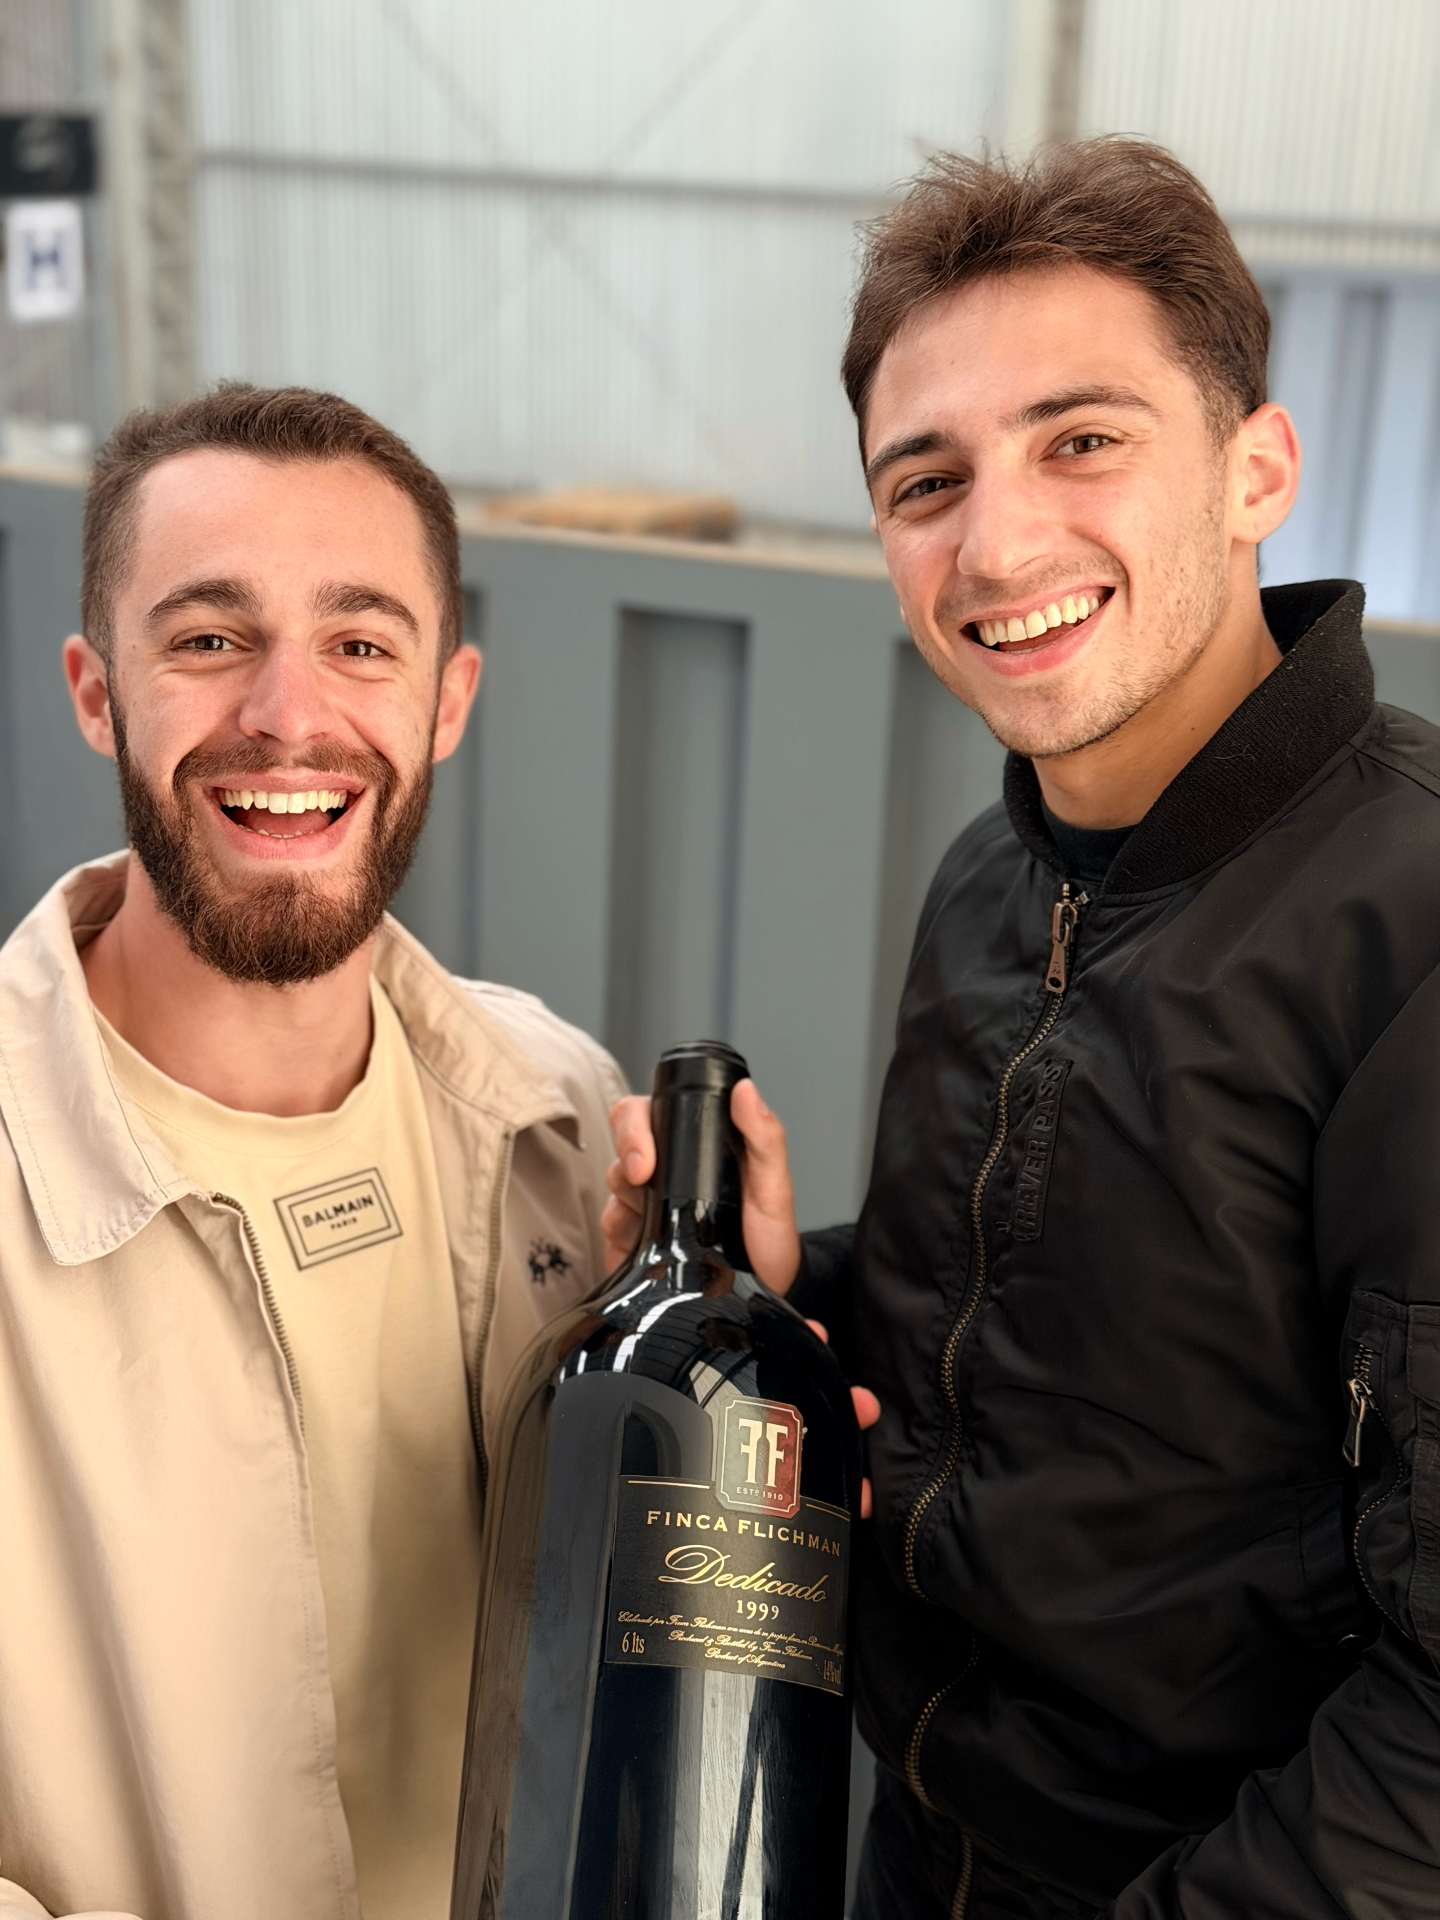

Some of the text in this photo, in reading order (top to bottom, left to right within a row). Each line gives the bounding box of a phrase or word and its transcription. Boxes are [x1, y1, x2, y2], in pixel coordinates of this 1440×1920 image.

[1033, 1066, 1063, 1131] PASS
[302, 1195, 374, 1228] BALMAIN
[762, 1490, 784, 1501] 1910
[647, 1510, 841, 1557] FINCA FLICHMAN
[658, 1544, 829, 1602] Dedicado
[736, 1600, 780, 1621] 1999
[622, 1631, 645, 1654] 6 lts
